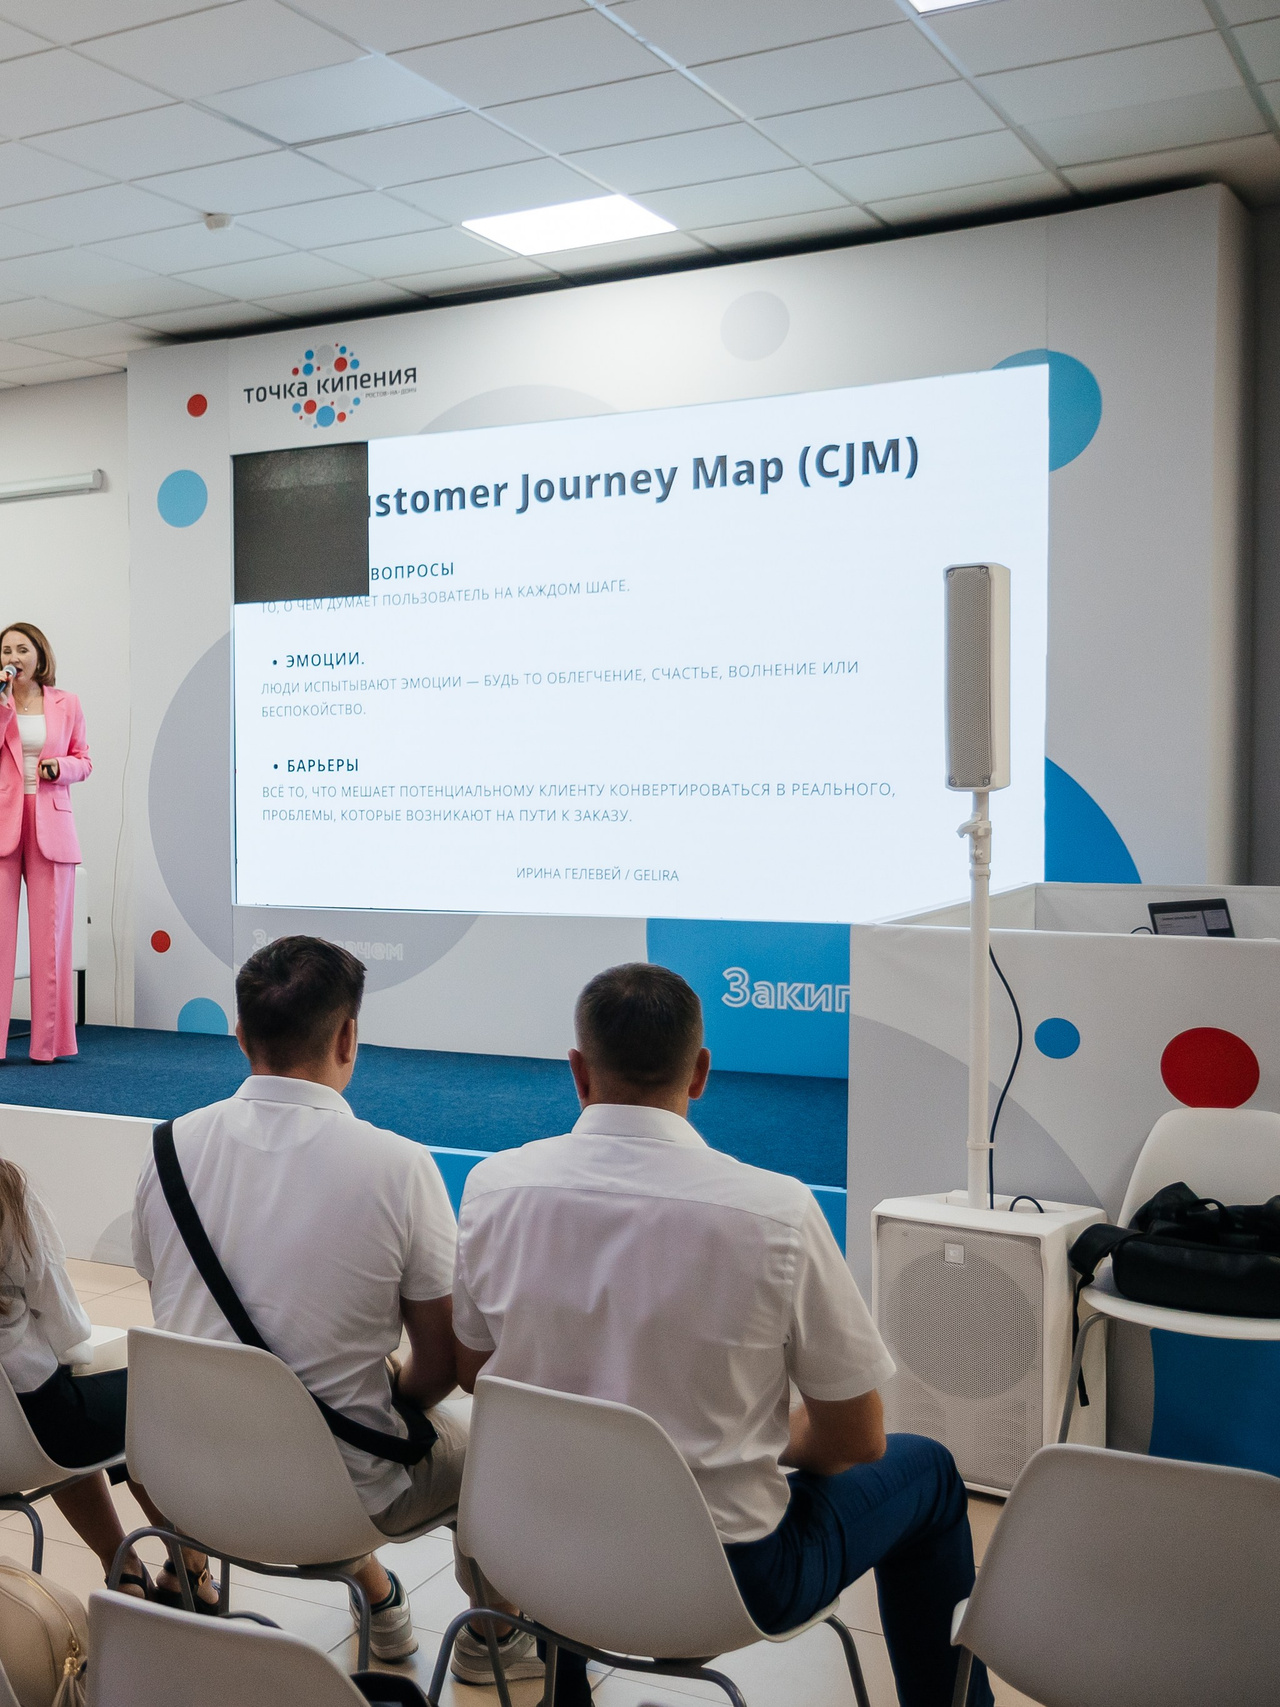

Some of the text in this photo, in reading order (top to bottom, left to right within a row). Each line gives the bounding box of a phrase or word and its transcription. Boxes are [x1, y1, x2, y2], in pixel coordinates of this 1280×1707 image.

[368, 436, 920, 518] stomer Journey Map (CJM)
[370, 562, 455, 581] ВОПРОСЫ
[296, 599, 323, 612] ЧЕМ
[327, 596, 378, 612] ДУМАЕТ
[382, 588, 490, 607] ПОЛЬЗОВАТЕЛЬ
[494, 586, 512, 600] НА
[517, 582, 581, 599] КАЖДОМ
[586, 579, 631, 594] ШАГЕ.
[285, 652, 365, 669] ЭМОЦИИ.
[261, 682, 300, 696] ЛЮДИ
[304, 678, 397, 694] ИСПЫТЫВАЮТ
[401, 676, 462, 691] ЭМОЦИИ
[483, 674, 519, 689] БУДЬ
[523, 672, 542, 685] ТО
[547, 668, 647, 684] ОБЛЕГЧЕНИЕ,
[651, 666, 723, 681] СЧАСТЬЕ,
[728, 662, 817, 678] ВОЛНЕНИЕ
[822, 661, 859, 675] ИЛИ
[261, 702, 367, 717] БЕСПОКОЙСТВО.
[286, 758, 359, 773] БАРЬЕРЫ
[262, 782, 896, 800] ВСЁ ТО, ЧТО МЕШАЕТ ПОТЕНЦИАЛЬНОМУ КЛИЕНТУ КОНВЕРТИРОВАТЬСЯ В РЕАЛЬНОГО,
[262, 809, 633, 823] ПРОБЛЕМЫ, КОТОРЫЕ ВОЗНИКАЮТ НА ПУТИ К ЗАКАЗУ.
[516, 867, 561, 880] ИРИНА
[564, 866, 621, 881] ГЕЛЕВЕЙ
[633, 869, 679, 881] GELIRA
